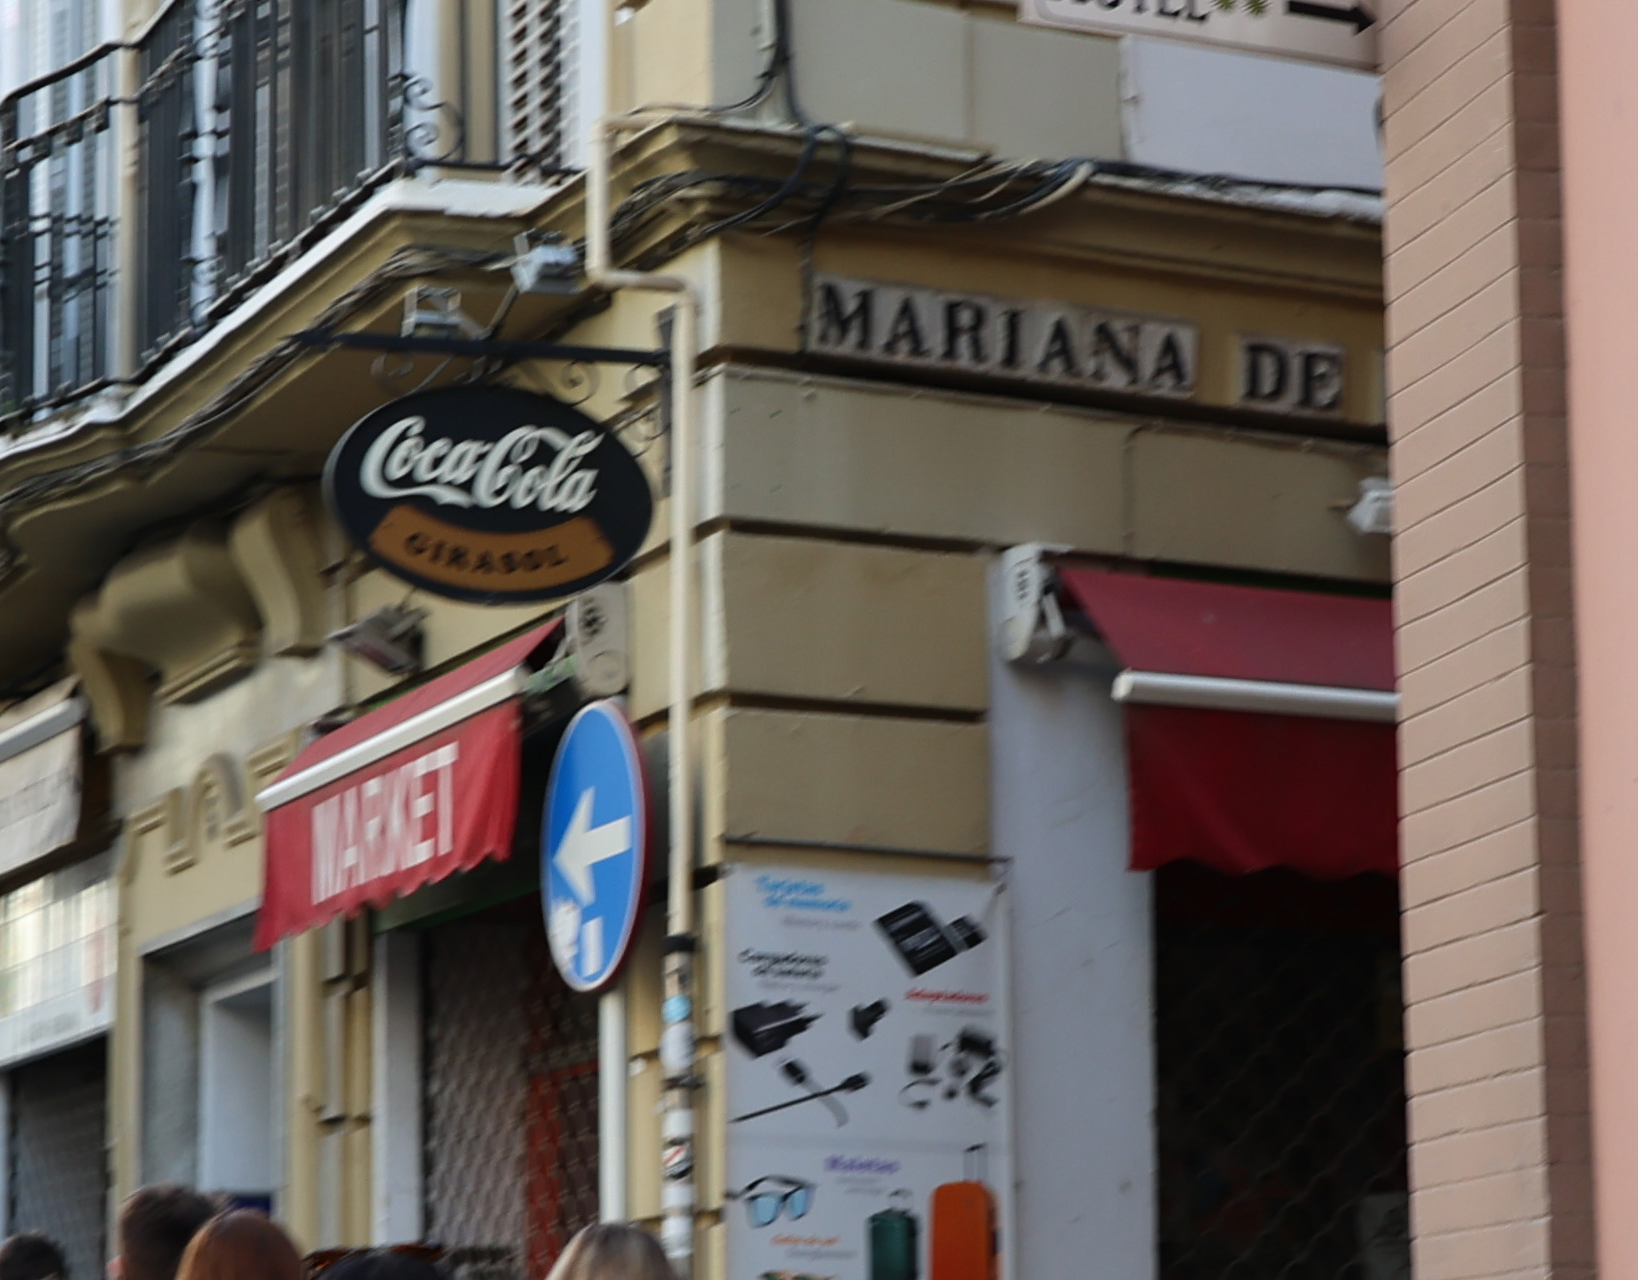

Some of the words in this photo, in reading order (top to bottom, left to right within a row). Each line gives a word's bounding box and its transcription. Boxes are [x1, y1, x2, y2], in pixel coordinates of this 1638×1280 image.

[819, 282, 1191, 389] MARIANA
[1242, 342, 1343, 410] DE
[311, 740, 459, 906] MARKET
